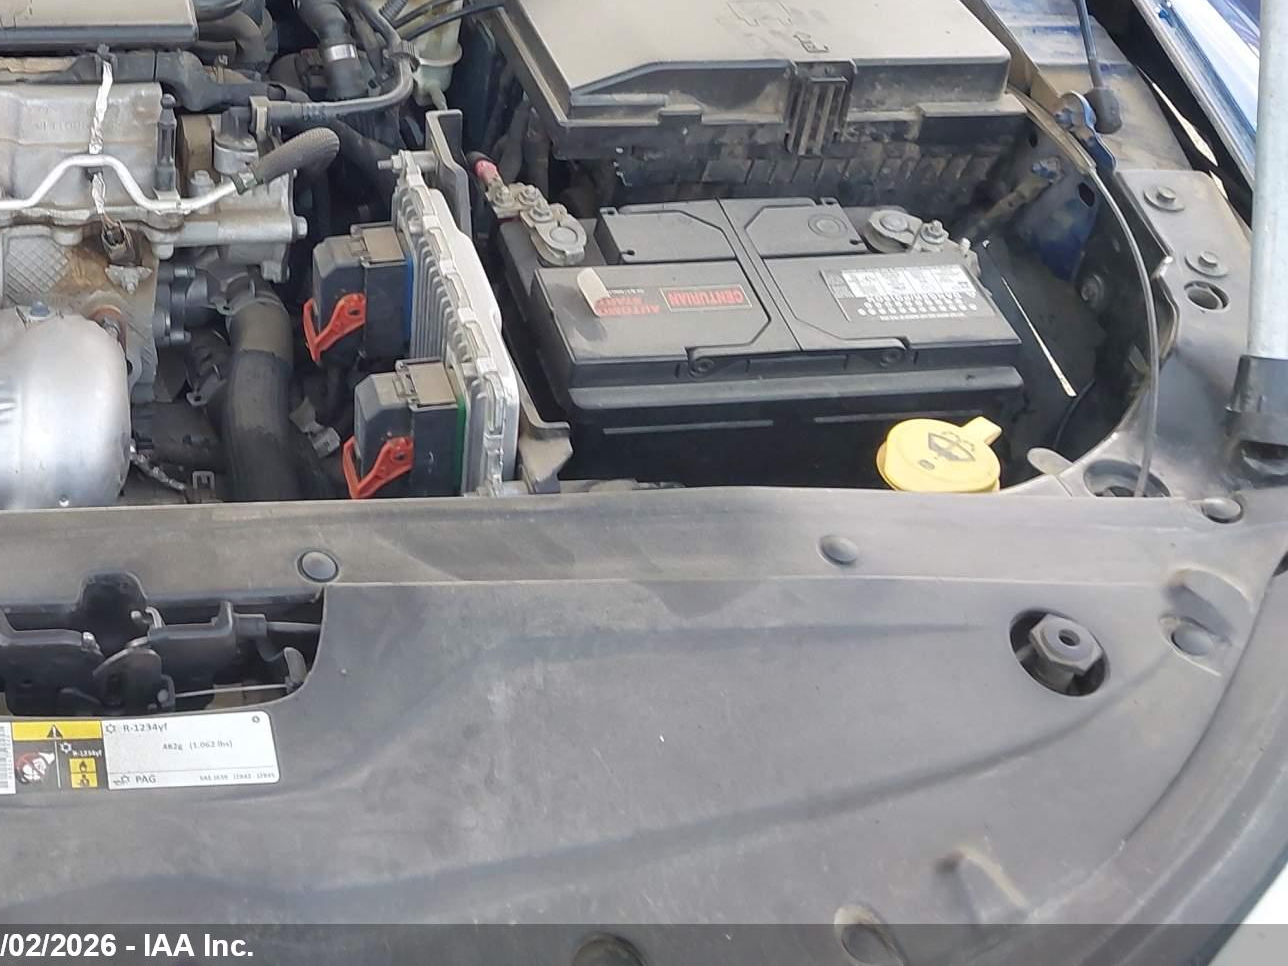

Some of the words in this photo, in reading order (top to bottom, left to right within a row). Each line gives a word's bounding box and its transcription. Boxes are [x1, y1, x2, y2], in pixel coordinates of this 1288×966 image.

[668, 289, 744, 307] CENTURIAN
[123, 722, 168, 733] R-1234yf
[135, 775, 157, 784] PAG
